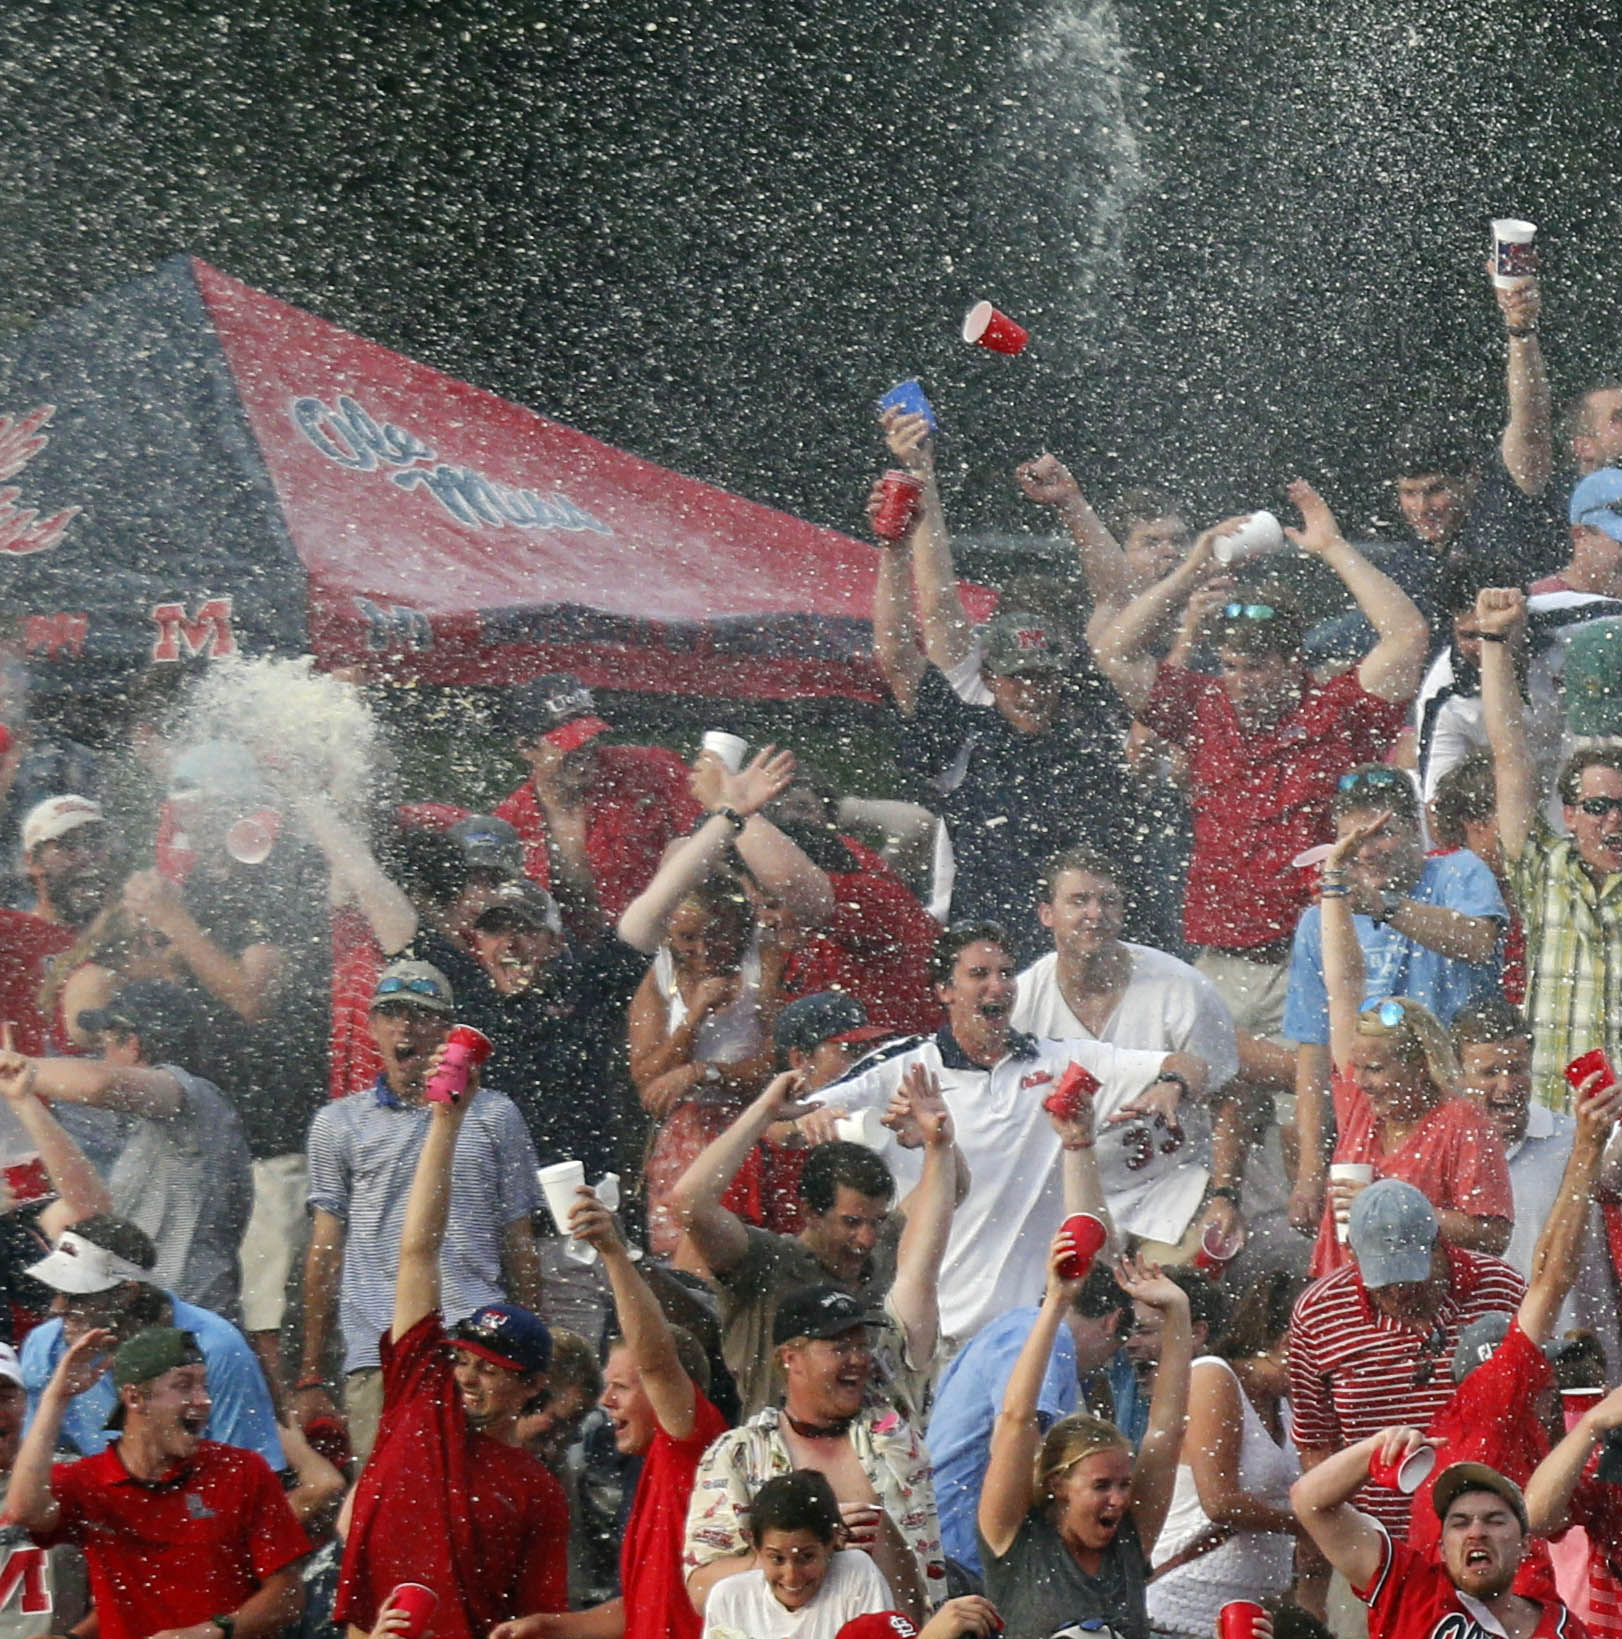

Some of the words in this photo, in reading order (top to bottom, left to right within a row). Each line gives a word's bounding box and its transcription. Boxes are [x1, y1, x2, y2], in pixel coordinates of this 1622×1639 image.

[291, 395, 438, 471] Ole
[391, 464, 613, 535] Miss
[152, 598, 236, 662] M
